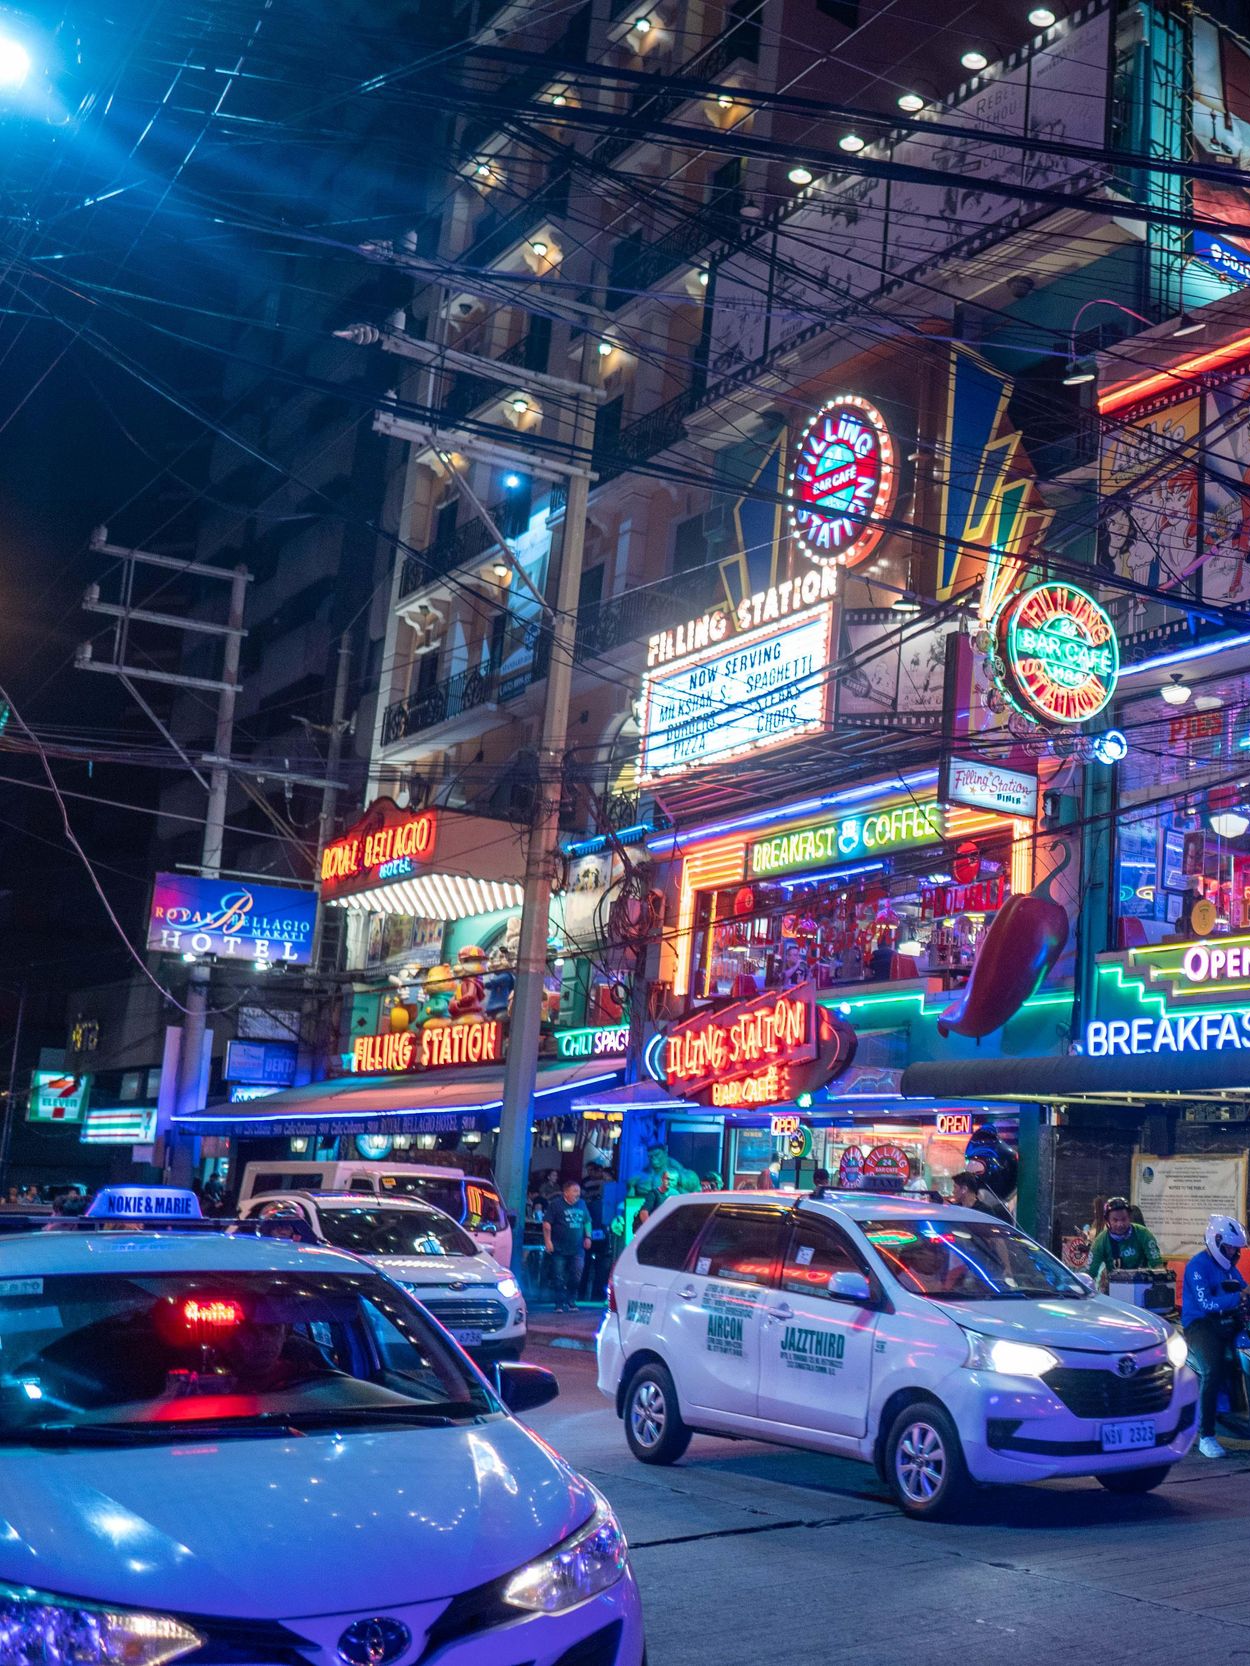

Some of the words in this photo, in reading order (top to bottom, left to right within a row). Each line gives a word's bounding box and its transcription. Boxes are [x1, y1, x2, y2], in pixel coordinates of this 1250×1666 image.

[796, 413, 874, 482] FILLING
[813, 479, 832, 495] BAR
[647, 610, 727, 667] FILLING
[737, 566, 838, 629] STATION
[1023, 587, 1112, 645] FILLING
[1022, 628, 1062, 657] BAR
[688, 665, 719, 691] NOW
[724, 642, 782, 677] SERVING
[745, 653, 815, 694] SPAGHETTI
[1019, 658, 1107, 719] STATION
[673, 736, 706, 760] PIZZA
[756, 704, 798, 734] CHOPS
[1168, 711, 1223, 746] PIES
[953, 769, 989, 791] Filling
[989, 775, 1032, 796] Station
[996, 793, 1022, 805] DINER
[752, 826, 835, 873] BREAKFAST
[862, 803, 938, 848] COFFEE
[321, 840, 359, 880] ROYAL
[379, 856, 412, 879] HOTEL
[155, 906, 214, 925] ROYAL
[231, 914, 310, 933] BELLAGIO
[251, 928, 305, 940] MAKATI
[160, 929, 298, 961] HOTEL
[730, 999, 806, 1062] STATION
[354, 1032, 413, 1072] FILLING
[421, 1021, 497, 1067] STATION
[562, 1035, 592, 1056] CHILI
[712, 1079, 740, 1107] BAR
[773, 1116, 799, 1135] OPEN
[937, 1115, 971, 1134] OPEN
[866, 1146, 908, 1169] FILLING
[882, 1158, 893, 1166] 24
[108, 1195, 143, 1214] NOKIE
[144, 1196, 153, 1214] &
[155, 1197, 191, 1214] MARIE
[707, 1313, 744, 1342] AIRCON
[780, 1326, 845, 1359] JAZZTHIRD
[1130, 1426, 1154, 1443] 2323
